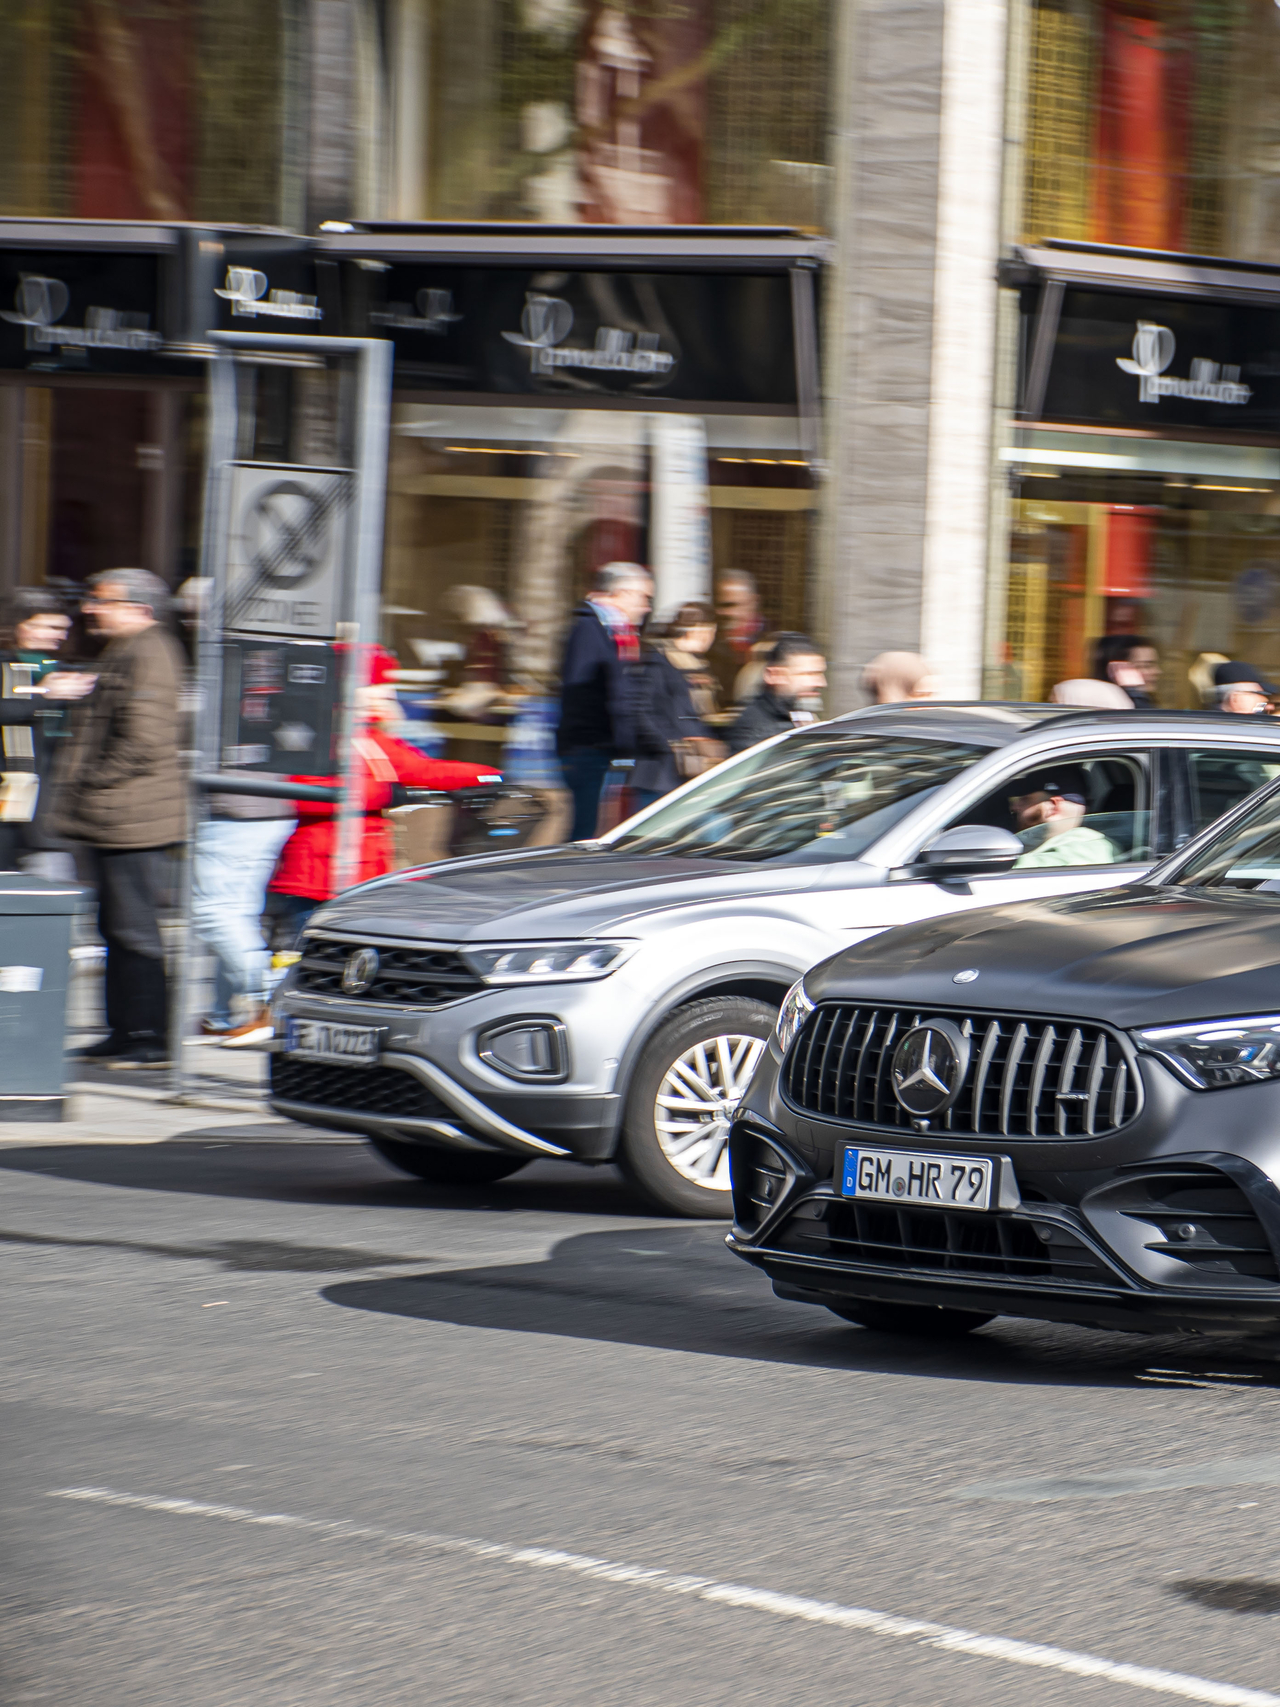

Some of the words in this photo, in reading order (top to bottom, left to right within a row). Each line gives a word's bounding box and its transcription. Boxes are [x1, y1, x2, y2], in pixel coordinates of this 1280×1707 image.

[858, 1156, 892, 1194] GM
[907, 1160, 943, 1199] HR
[951, 1164, 985, 1202] 79
